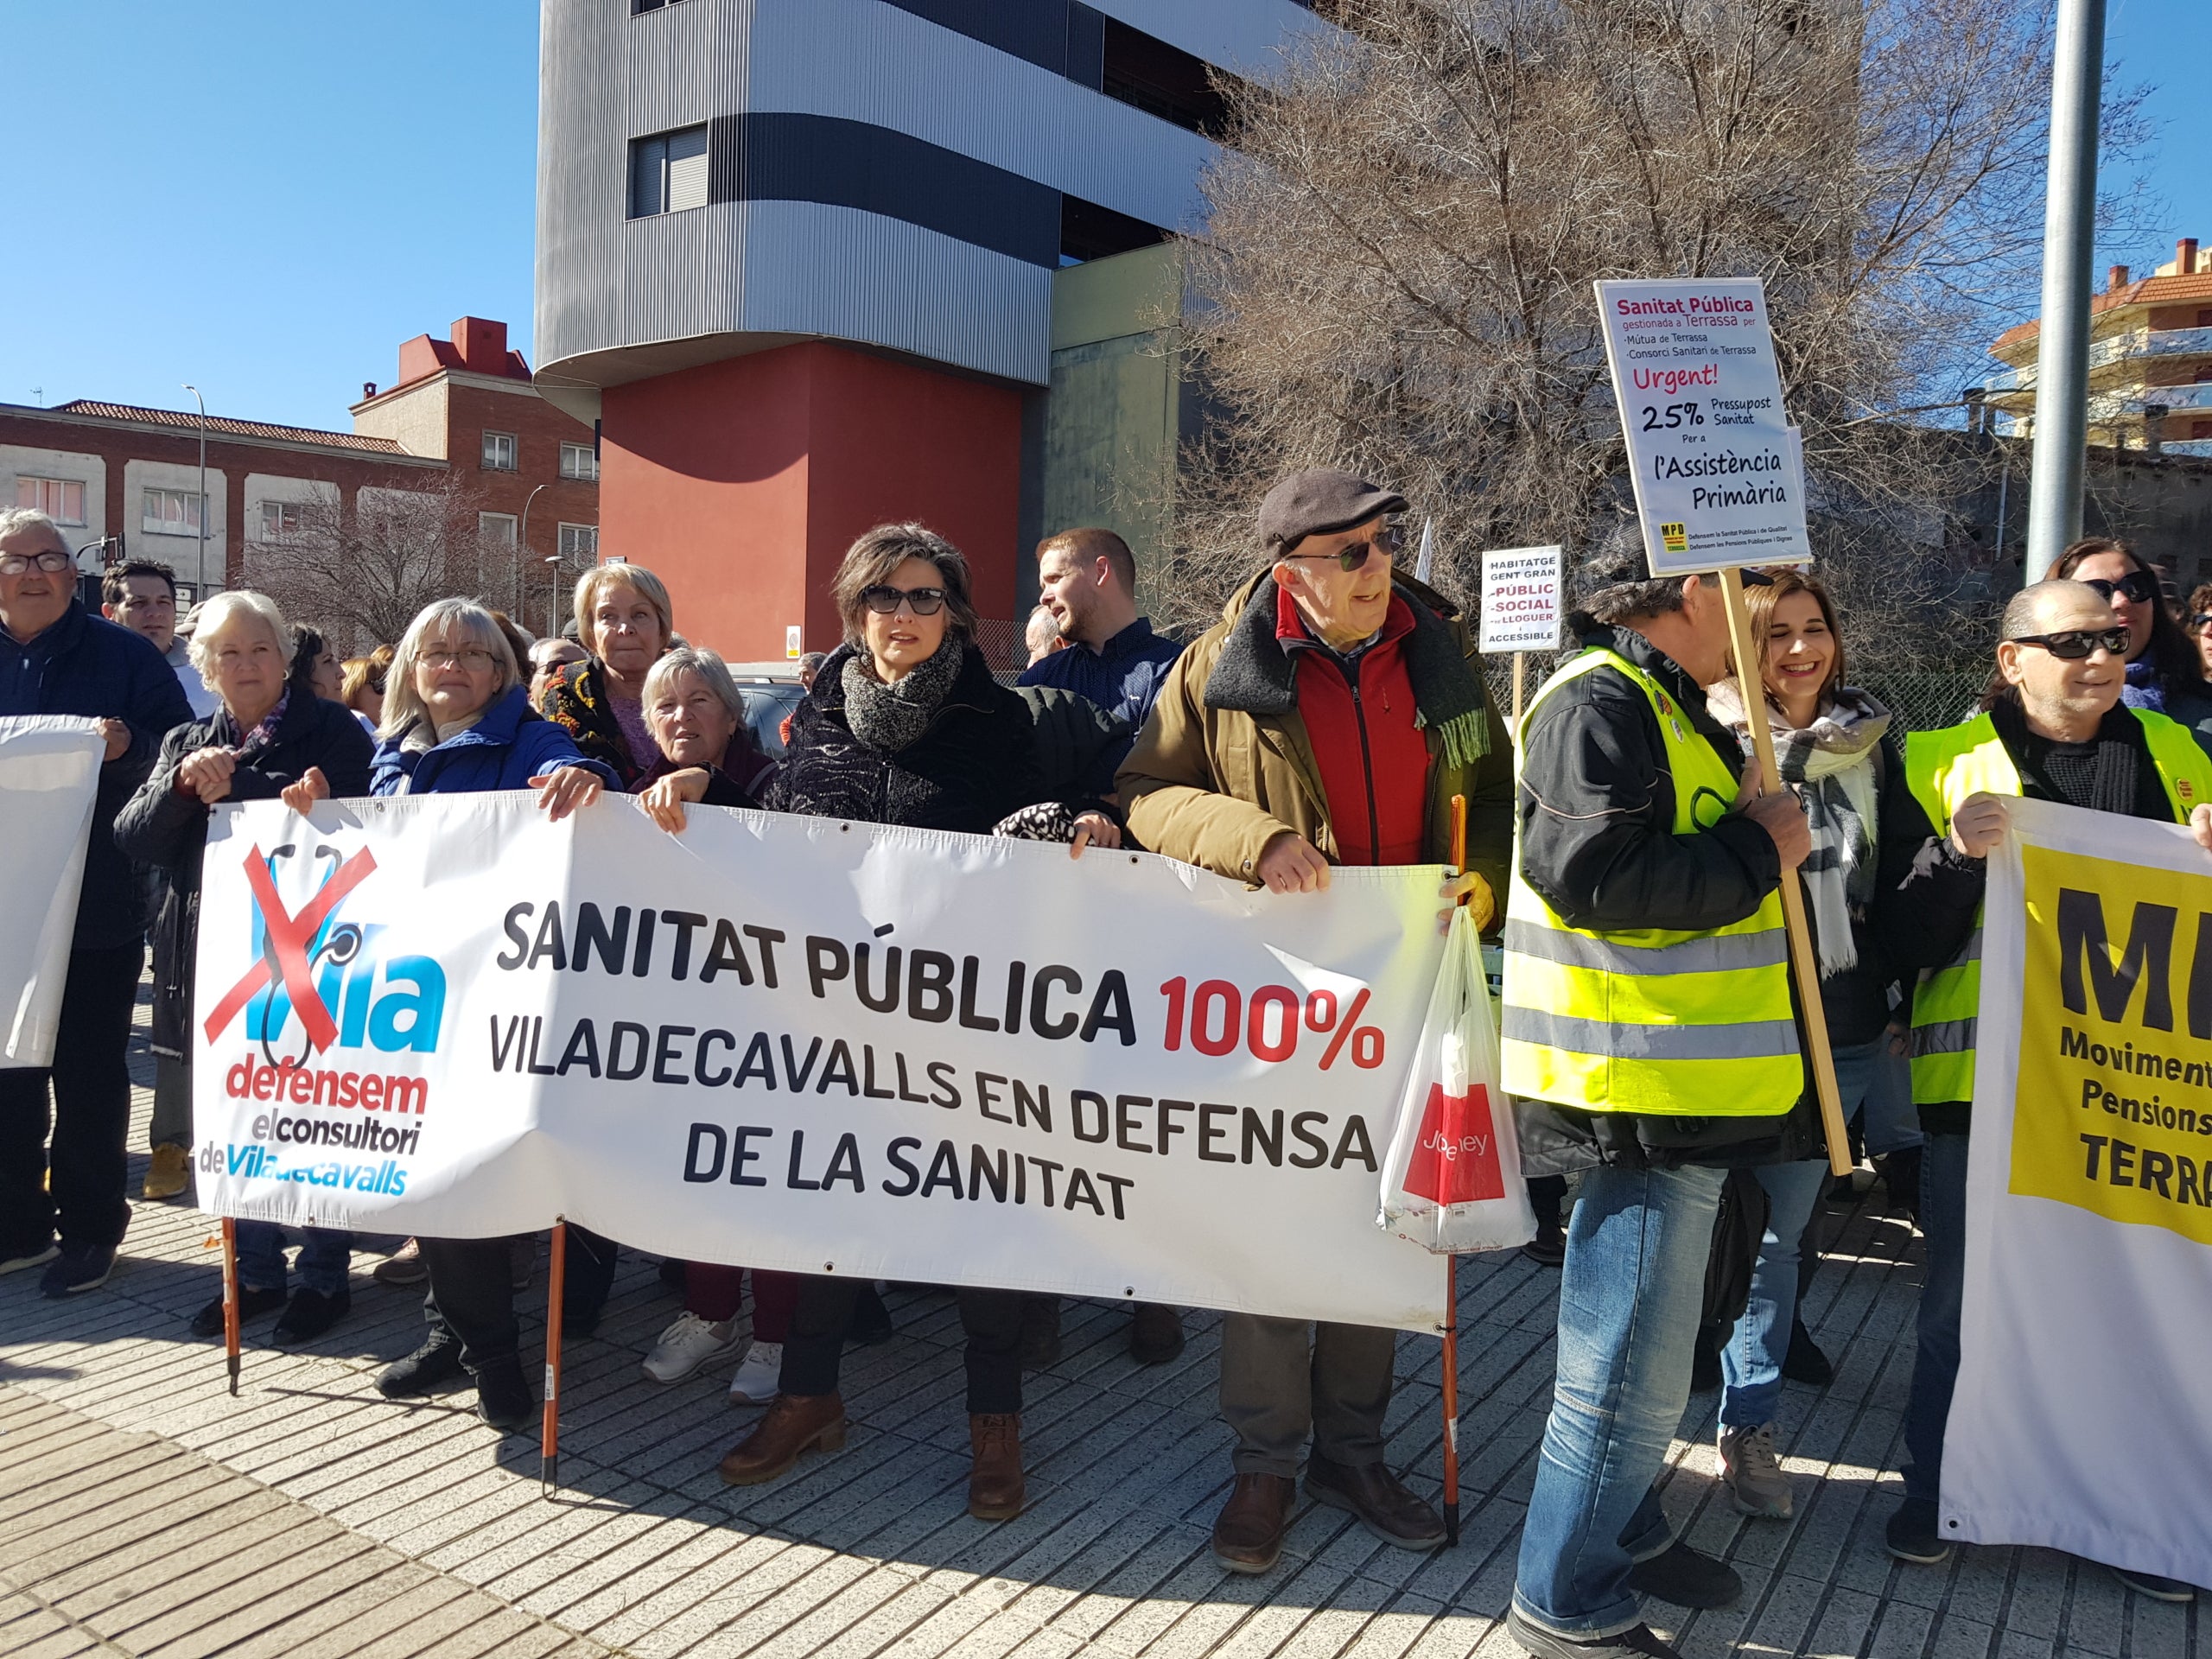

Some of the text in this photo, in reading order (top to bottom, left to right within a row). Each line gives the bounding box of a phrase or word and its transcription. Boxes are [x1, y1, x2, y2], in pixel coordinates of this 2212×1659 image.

[1618, 296, 1754, 315] Sanitat Pública
[1623, 319, 1674, 331] gestionada
[1683, 314, 1738, 327] Terrassa
[1744, 318, 1756, 327] per
[1671, 334, 1707, 343] Terrassa
[1720, 346, 1757, 355] Terrassa
[1634, 363, 1718, 395] Urgent!
[1642, 397, 1771, 432] 25% Pressupost
[1714, 413, 1755, 426] Sanitat
[1682, 435, 1697, 443] Per
[1693, 480, 1787, 510] Primària
[1661, 524, 1684, 537] MPD
[1491, 556, 1556, 569] HABITATGE
[1491, 569, 1555, 581] GENT GRAN
[1503, 613, 1553, 623] LLOGUER
[1489, 632, 1554, 642] ACCESSIBLE
[496, 899, 1384, 1071] SANITAT PÚBLICA 100%
[226, 1052, 429, 1115] defensem
[490, 1014, 1378, 1173] VILADECAVALLS EN DEFENSA
[683, 1122, 1135, 1221] DE LA SANITAT
